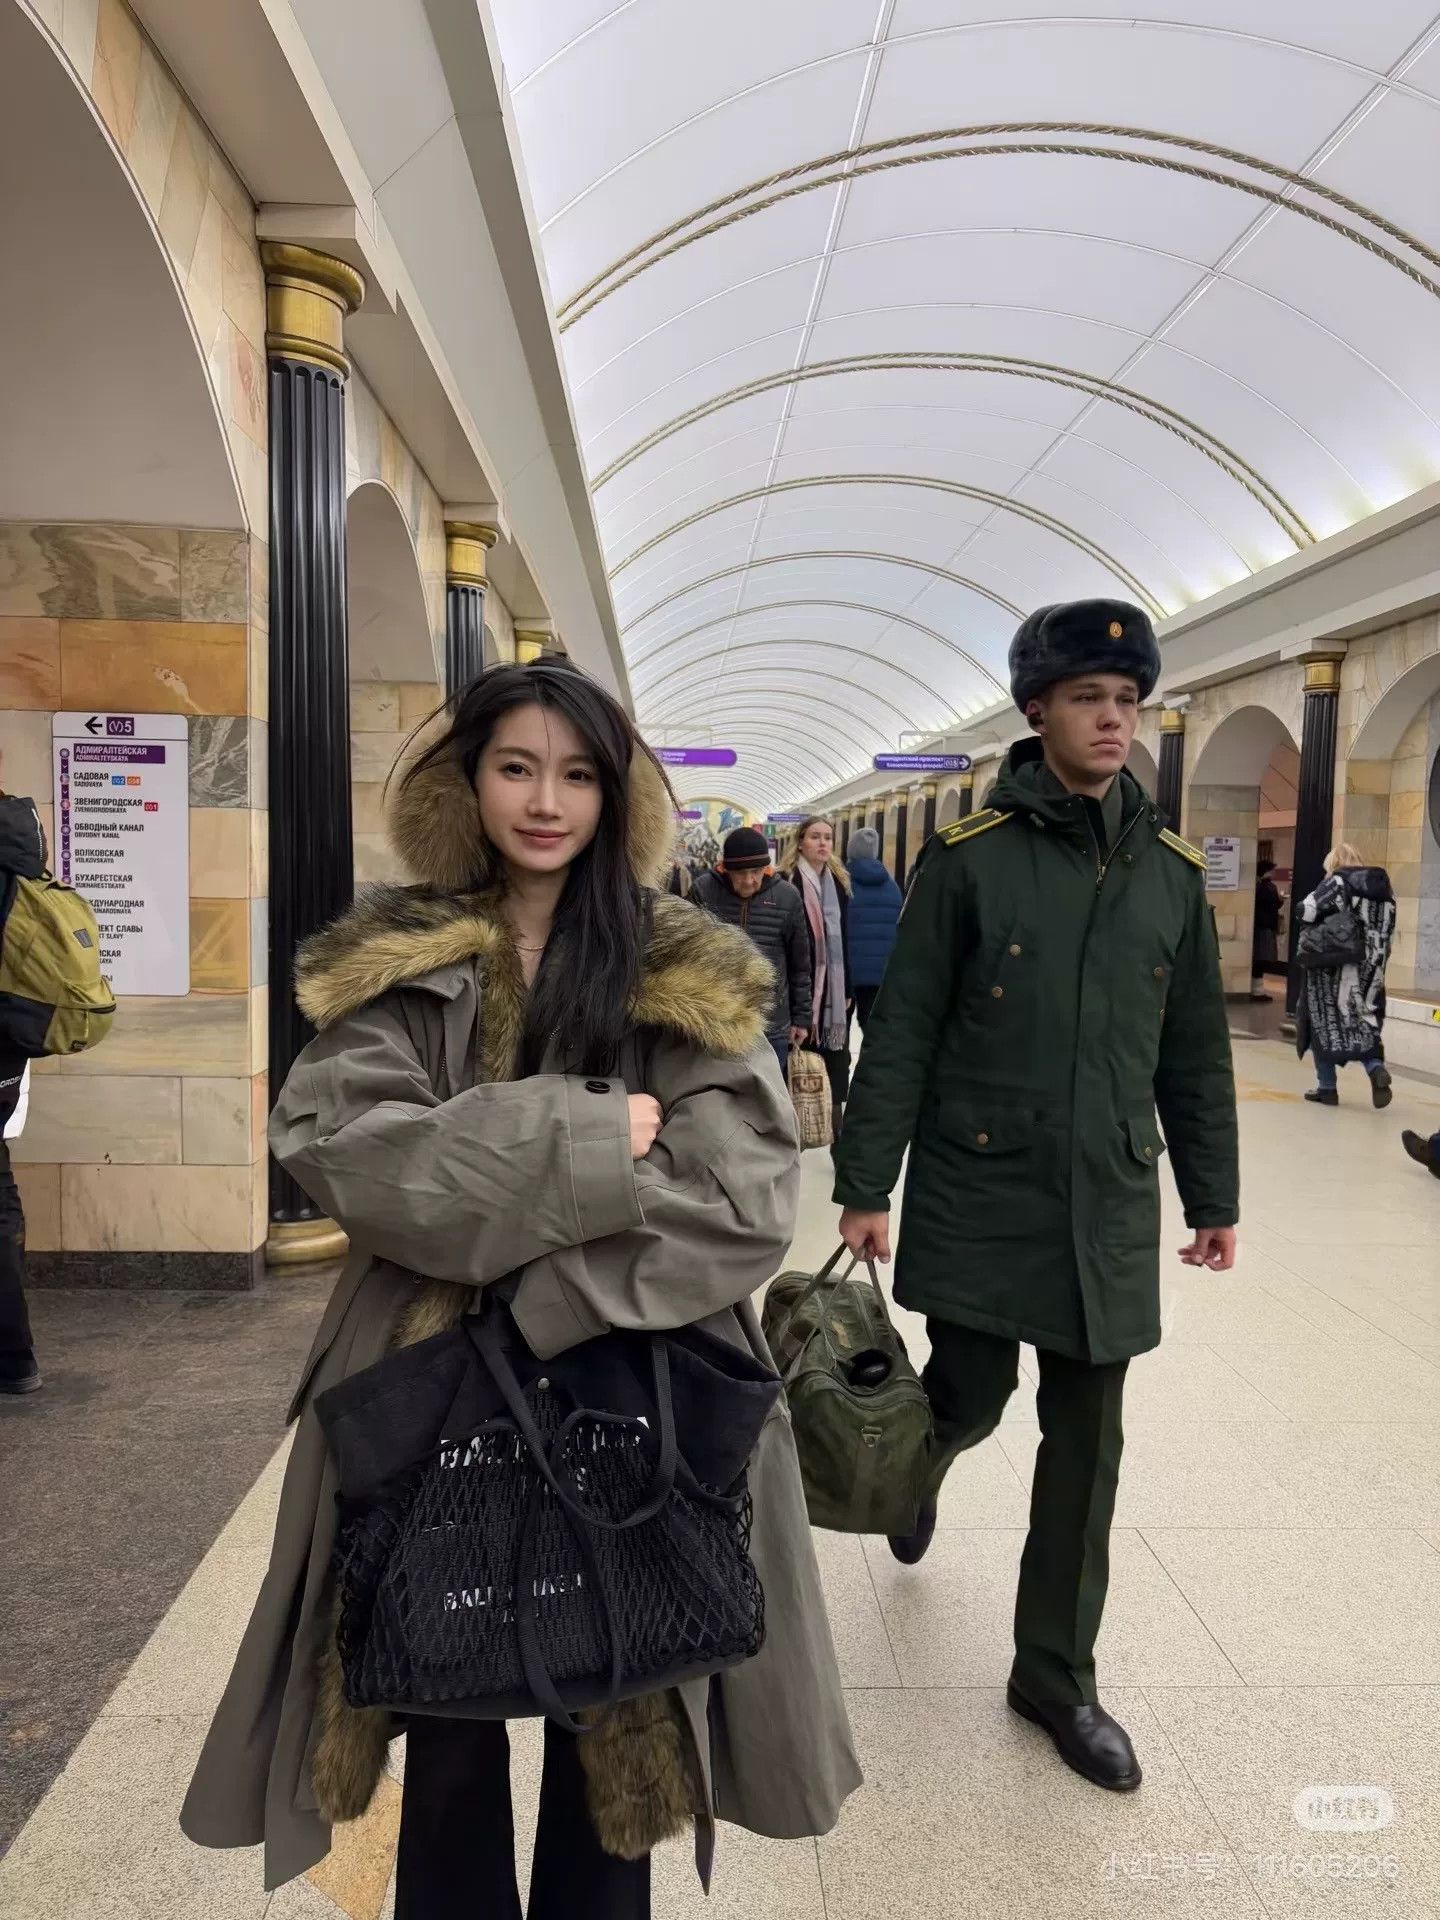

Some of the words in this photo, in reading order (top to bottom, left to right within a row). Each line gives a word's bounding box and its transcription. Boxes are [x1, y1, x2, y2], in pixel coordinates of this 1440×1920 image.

[75, 745, 148, 756] АДМИРАЛТЕЙСКАЯ
[73, 772, 109, 781] САДОВАЯ
[74, 798, 143, 807] ЗВЕНИГОРОДСКАЯ
[74, 822, 117, 832] ОБВОДНЫЙ
[118, 824, 145, 832] КАНАЛ
[74, 849, 125, 858] ВОЛКОВСКАЯ
[75, 874, 133, 883] БУХАРЕСТСКАЯ
[116, 924, 143, 933] СЛАВЫ
